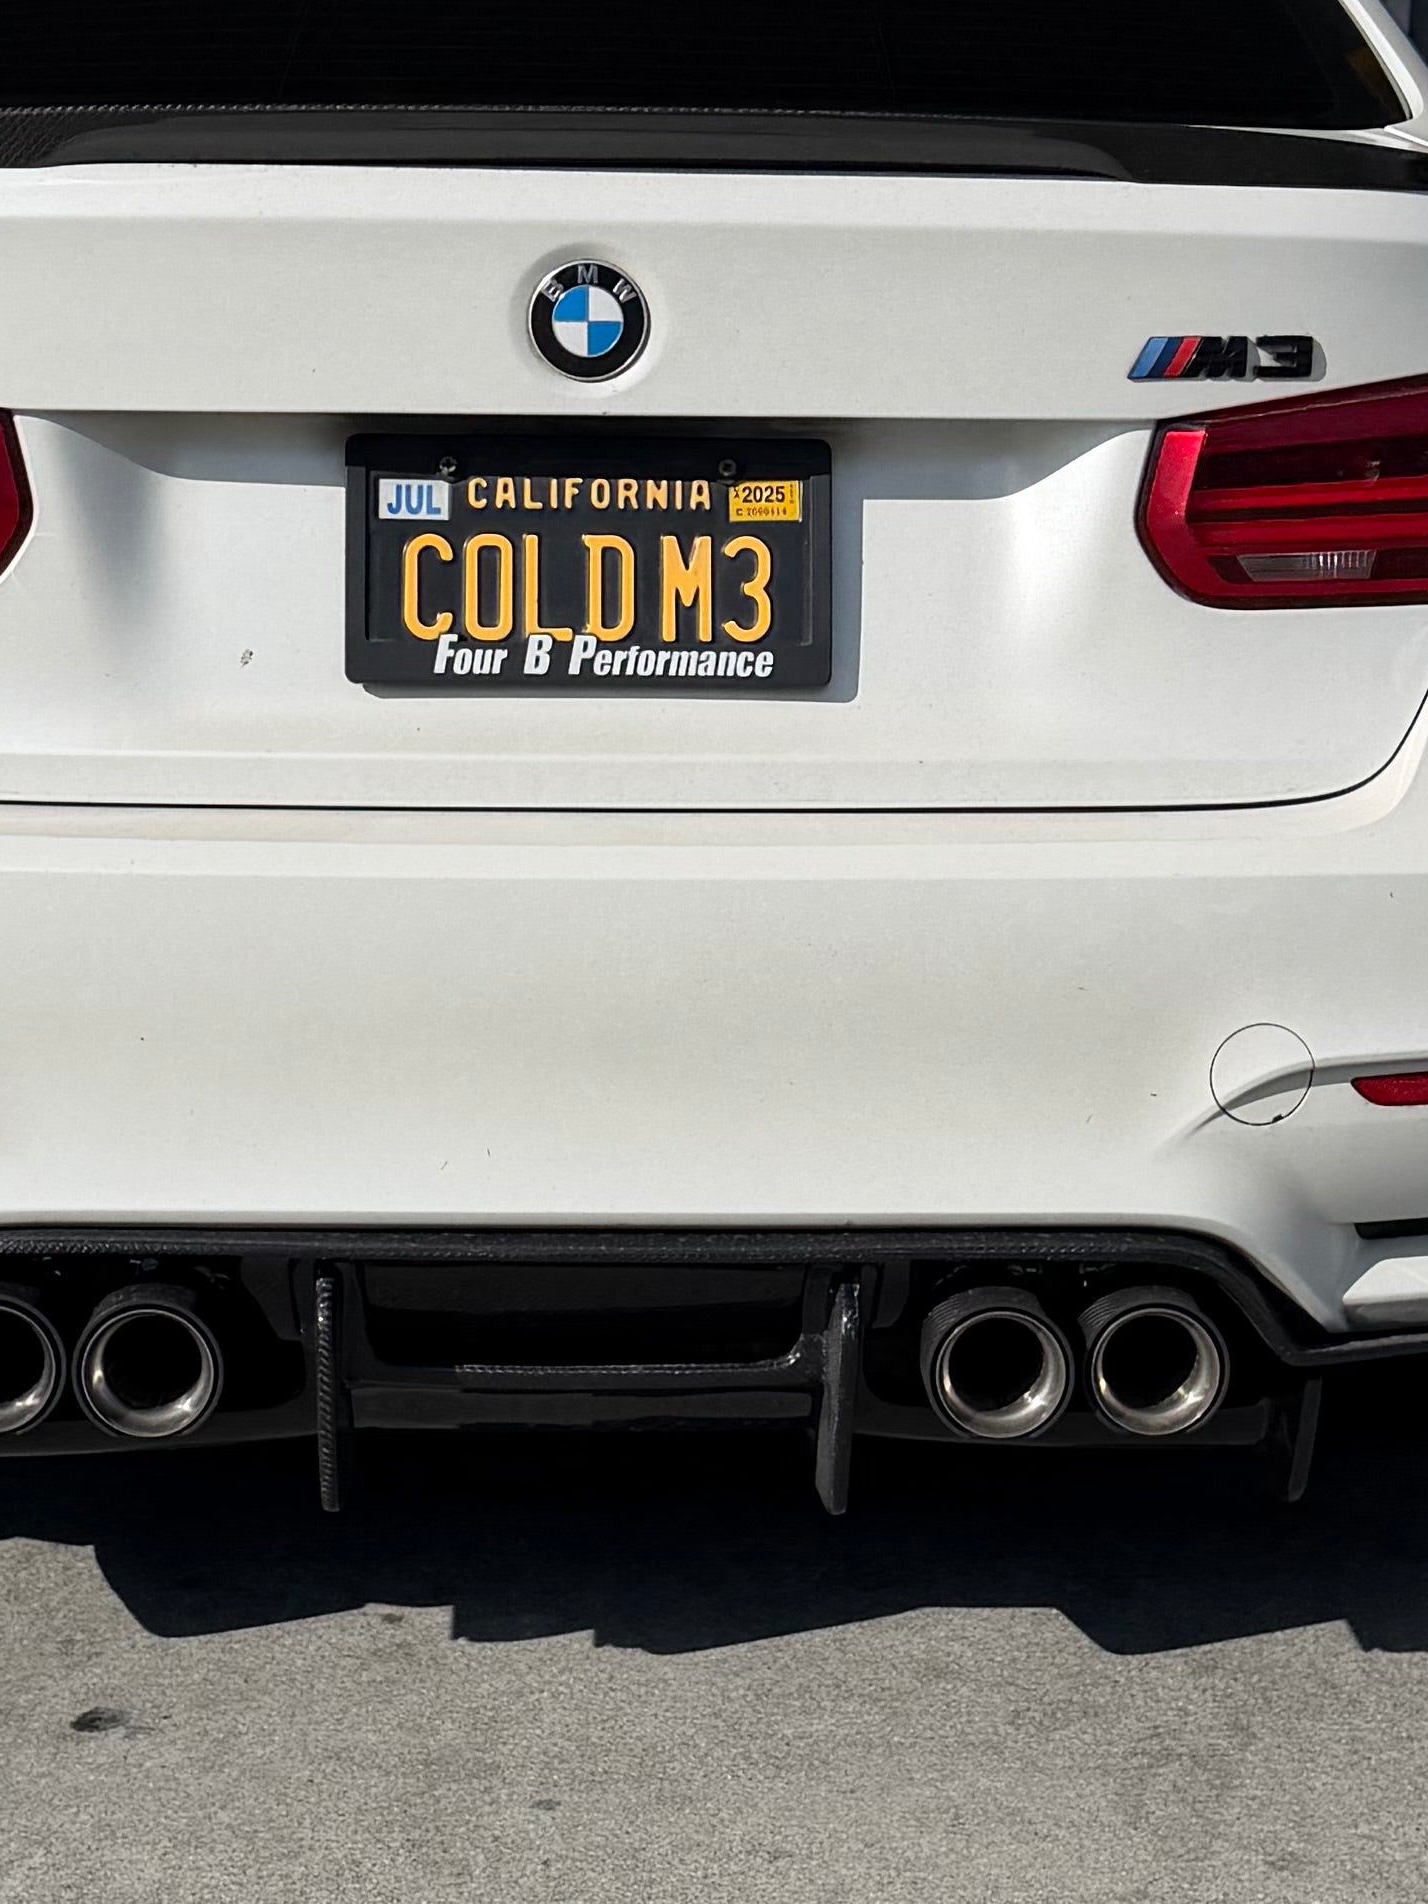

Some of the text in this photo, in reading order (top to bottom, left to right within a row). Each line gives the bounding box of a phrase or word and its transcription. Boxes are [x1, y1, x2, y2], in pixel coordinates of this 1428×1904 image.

[540, 264, 638, 304] BMW
[1175, 335, 1313, 379] M3
[386, 484, 442, 515] JUL
[467, 477, 712, 511] CALIFORNIA
[742, 485, 786, 504] 2025
[433, 633, 774, 678] Four B Performance
